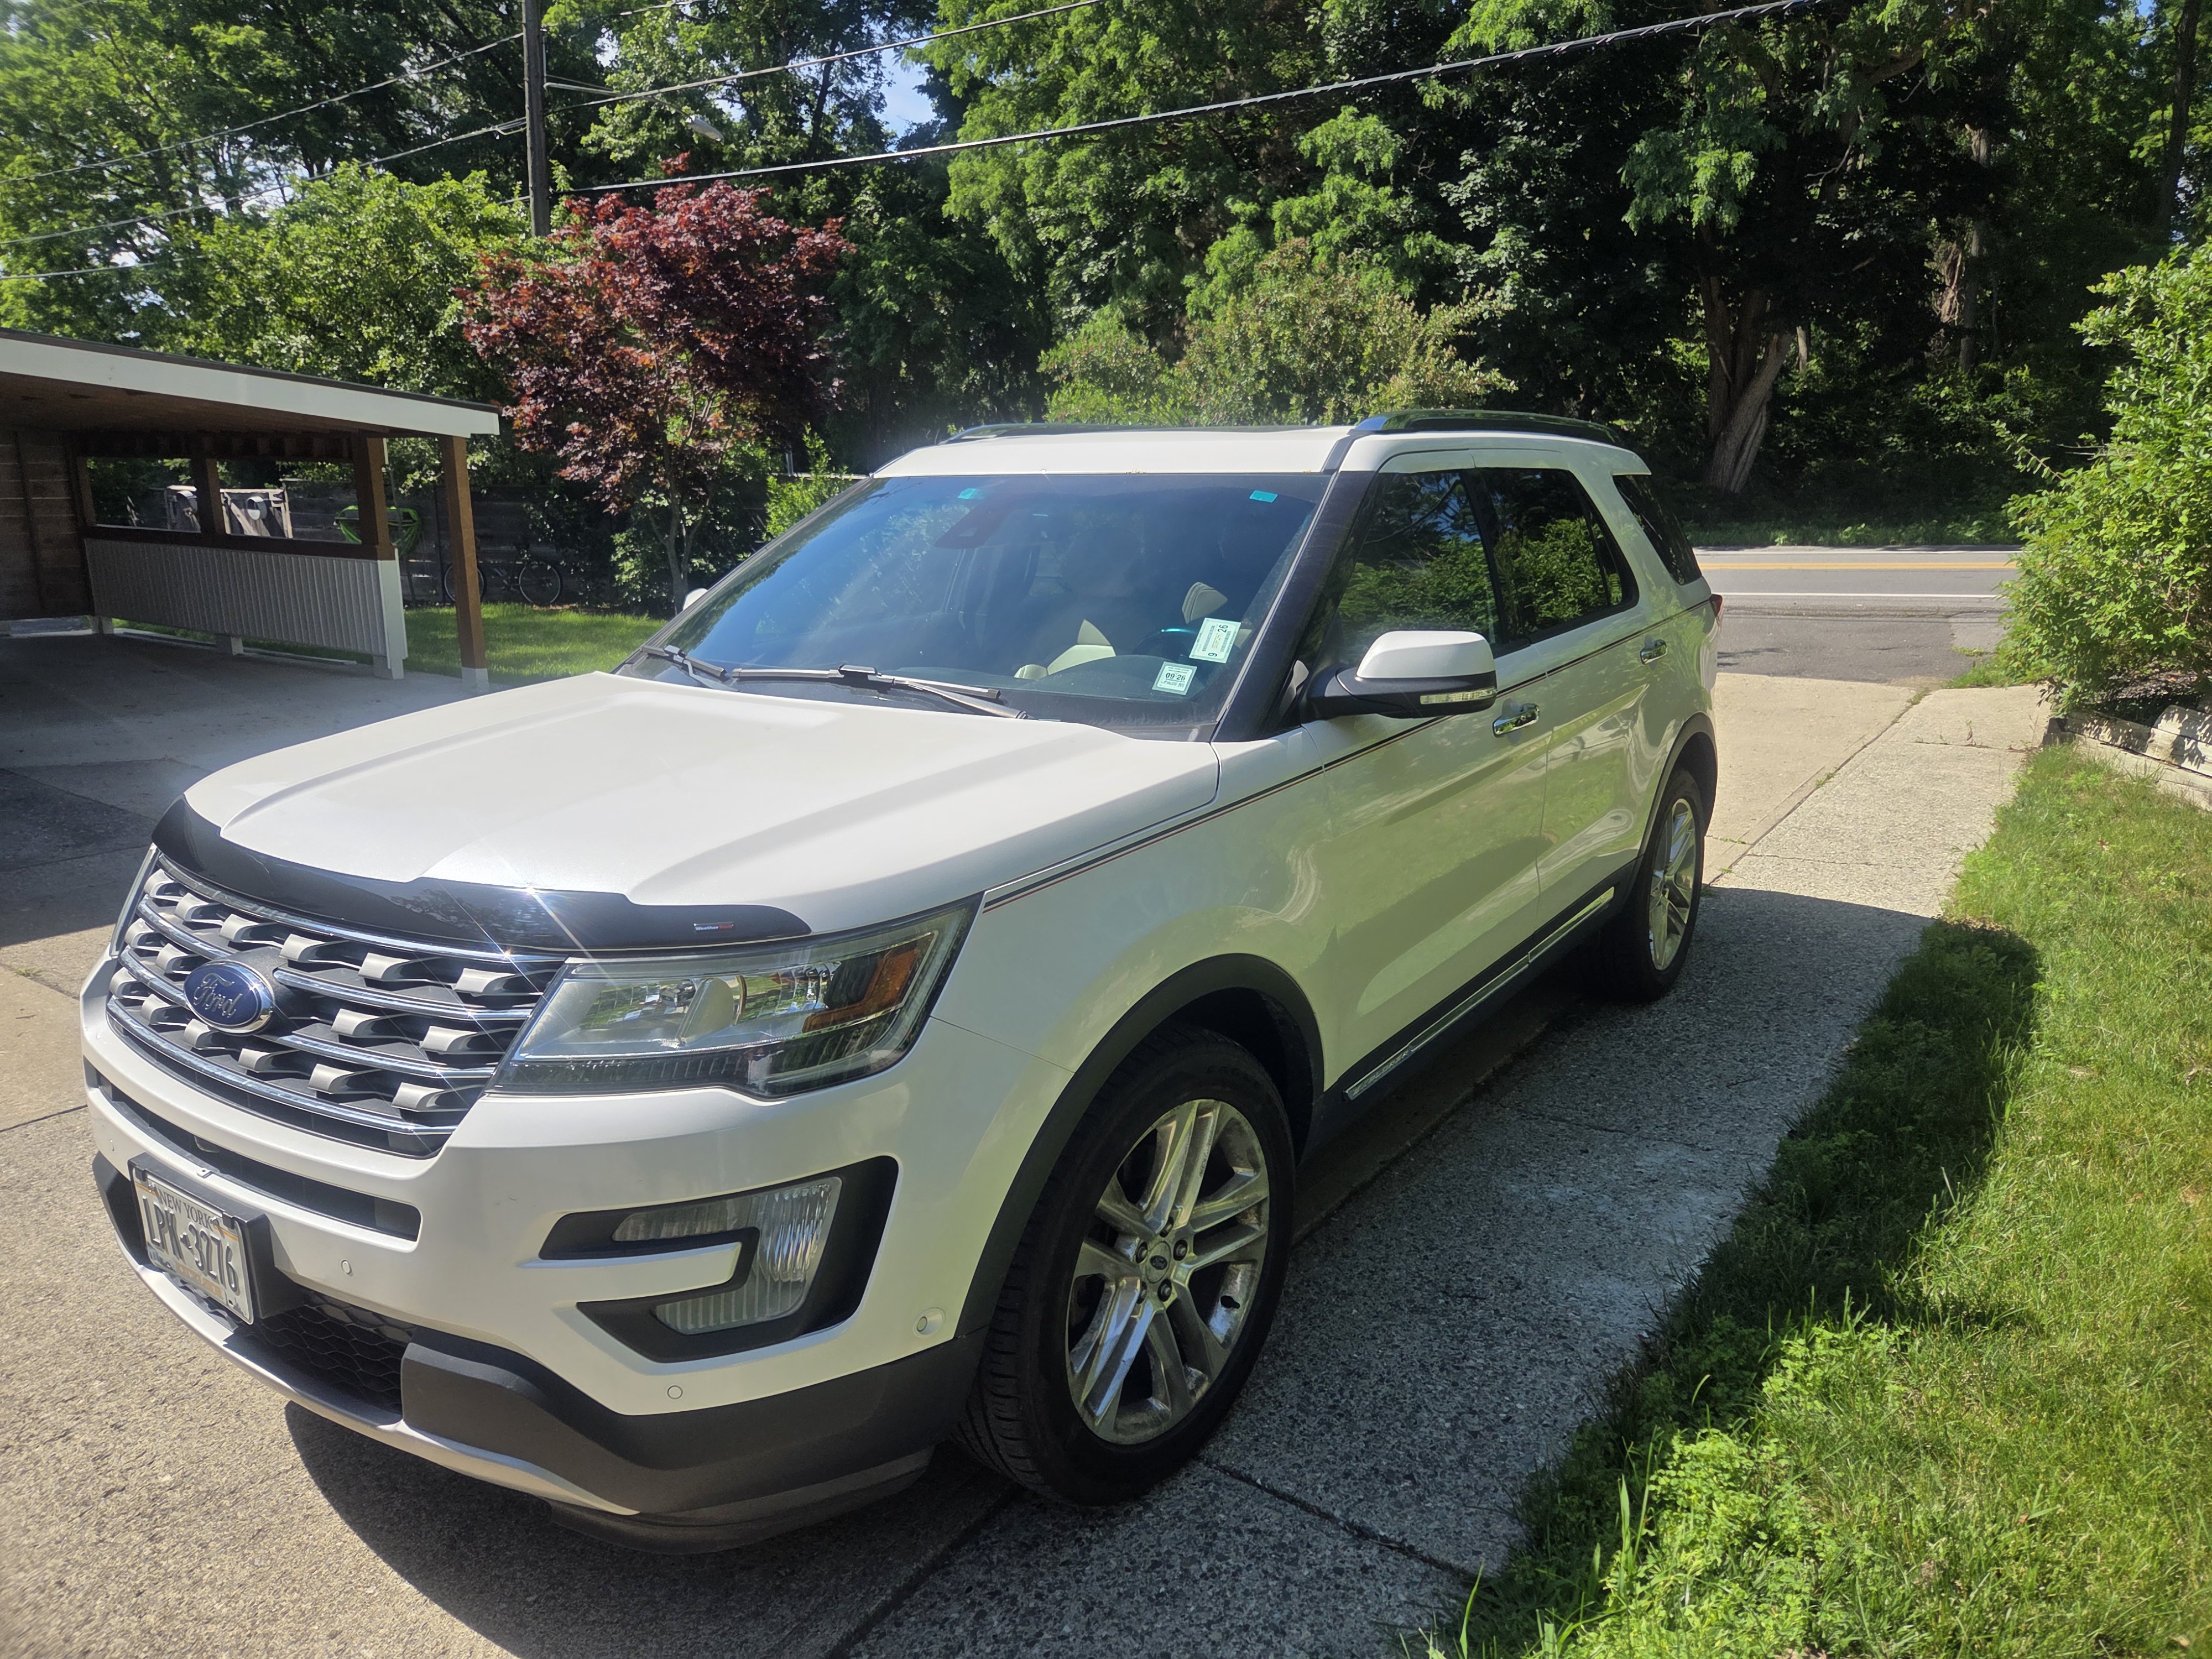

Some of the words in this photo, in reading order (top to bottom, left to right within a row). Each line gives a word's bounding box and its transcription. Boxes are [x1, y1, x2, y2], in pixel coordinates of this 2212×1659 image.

[194, 972, 243, 1018] Ford
[158, 1188, 181, 1214] NEW
[183, 1201, 213, 1233] YORK
[188, 1221, 238, 1293] 3276
